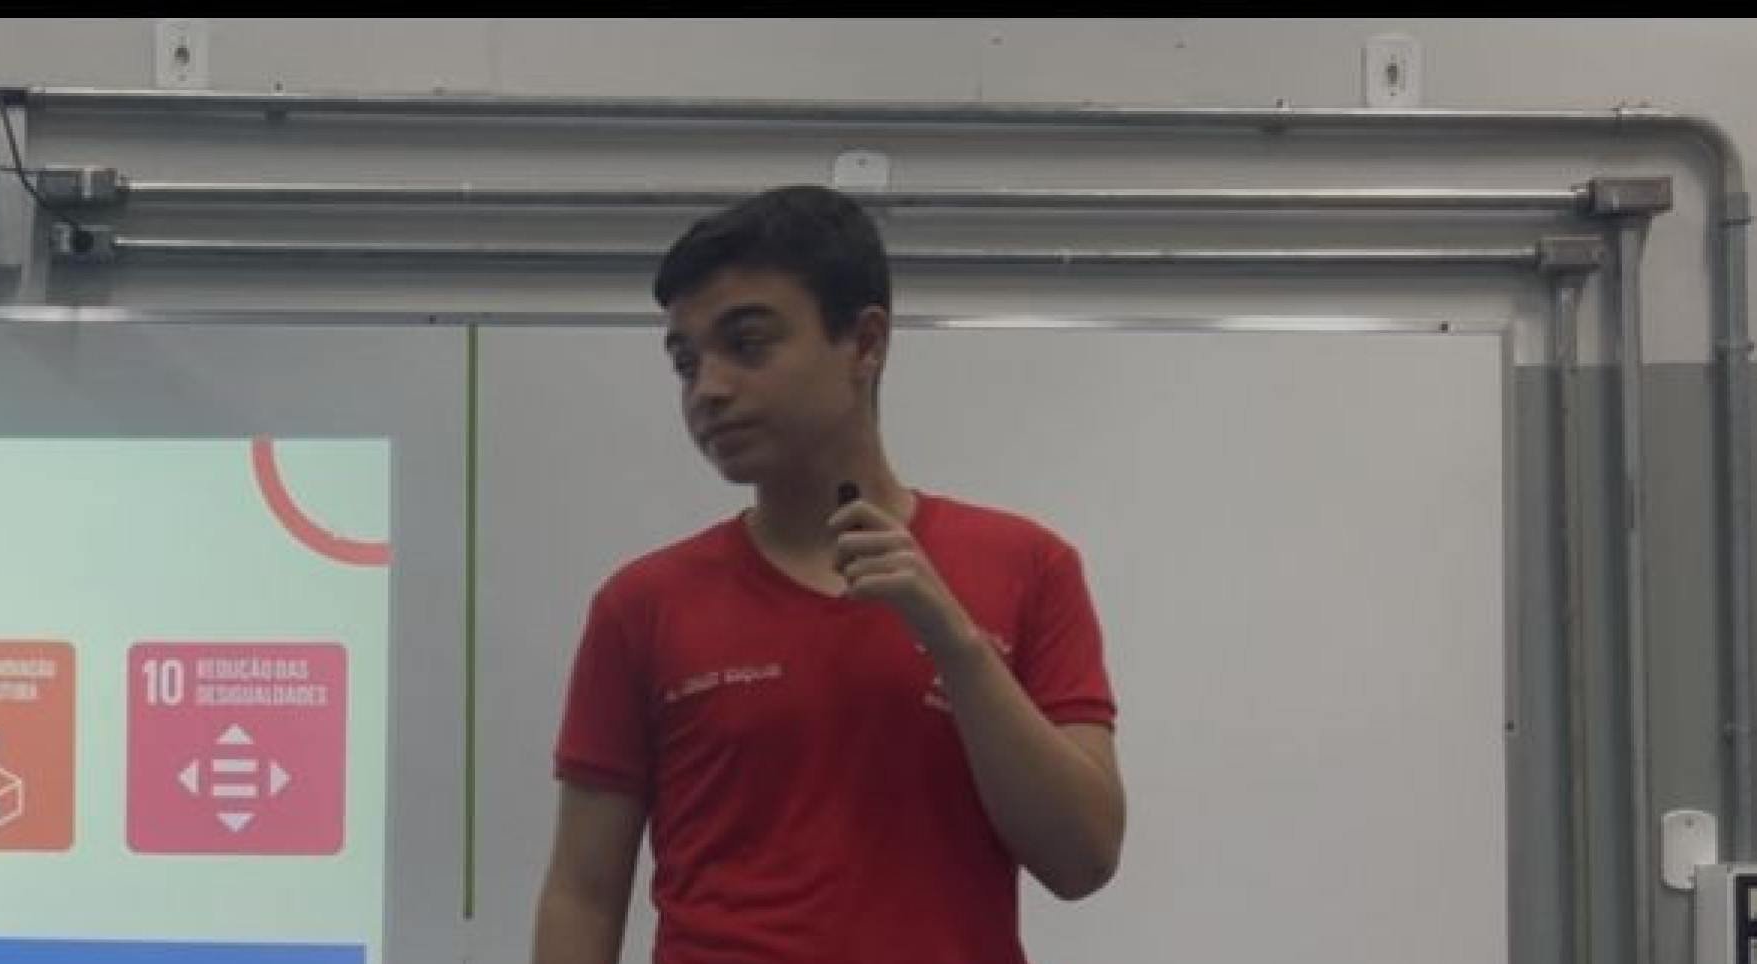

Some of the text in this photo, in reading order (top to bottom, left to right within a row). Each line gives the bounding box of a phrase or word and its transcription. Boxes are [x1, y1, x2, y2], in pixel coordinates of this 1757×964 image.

[196, 656, 310, 680] REDUÇÃO DAS
[142, 659, 184, 706] 10
[195, 683, 329, 707] DESIGUALDADES
